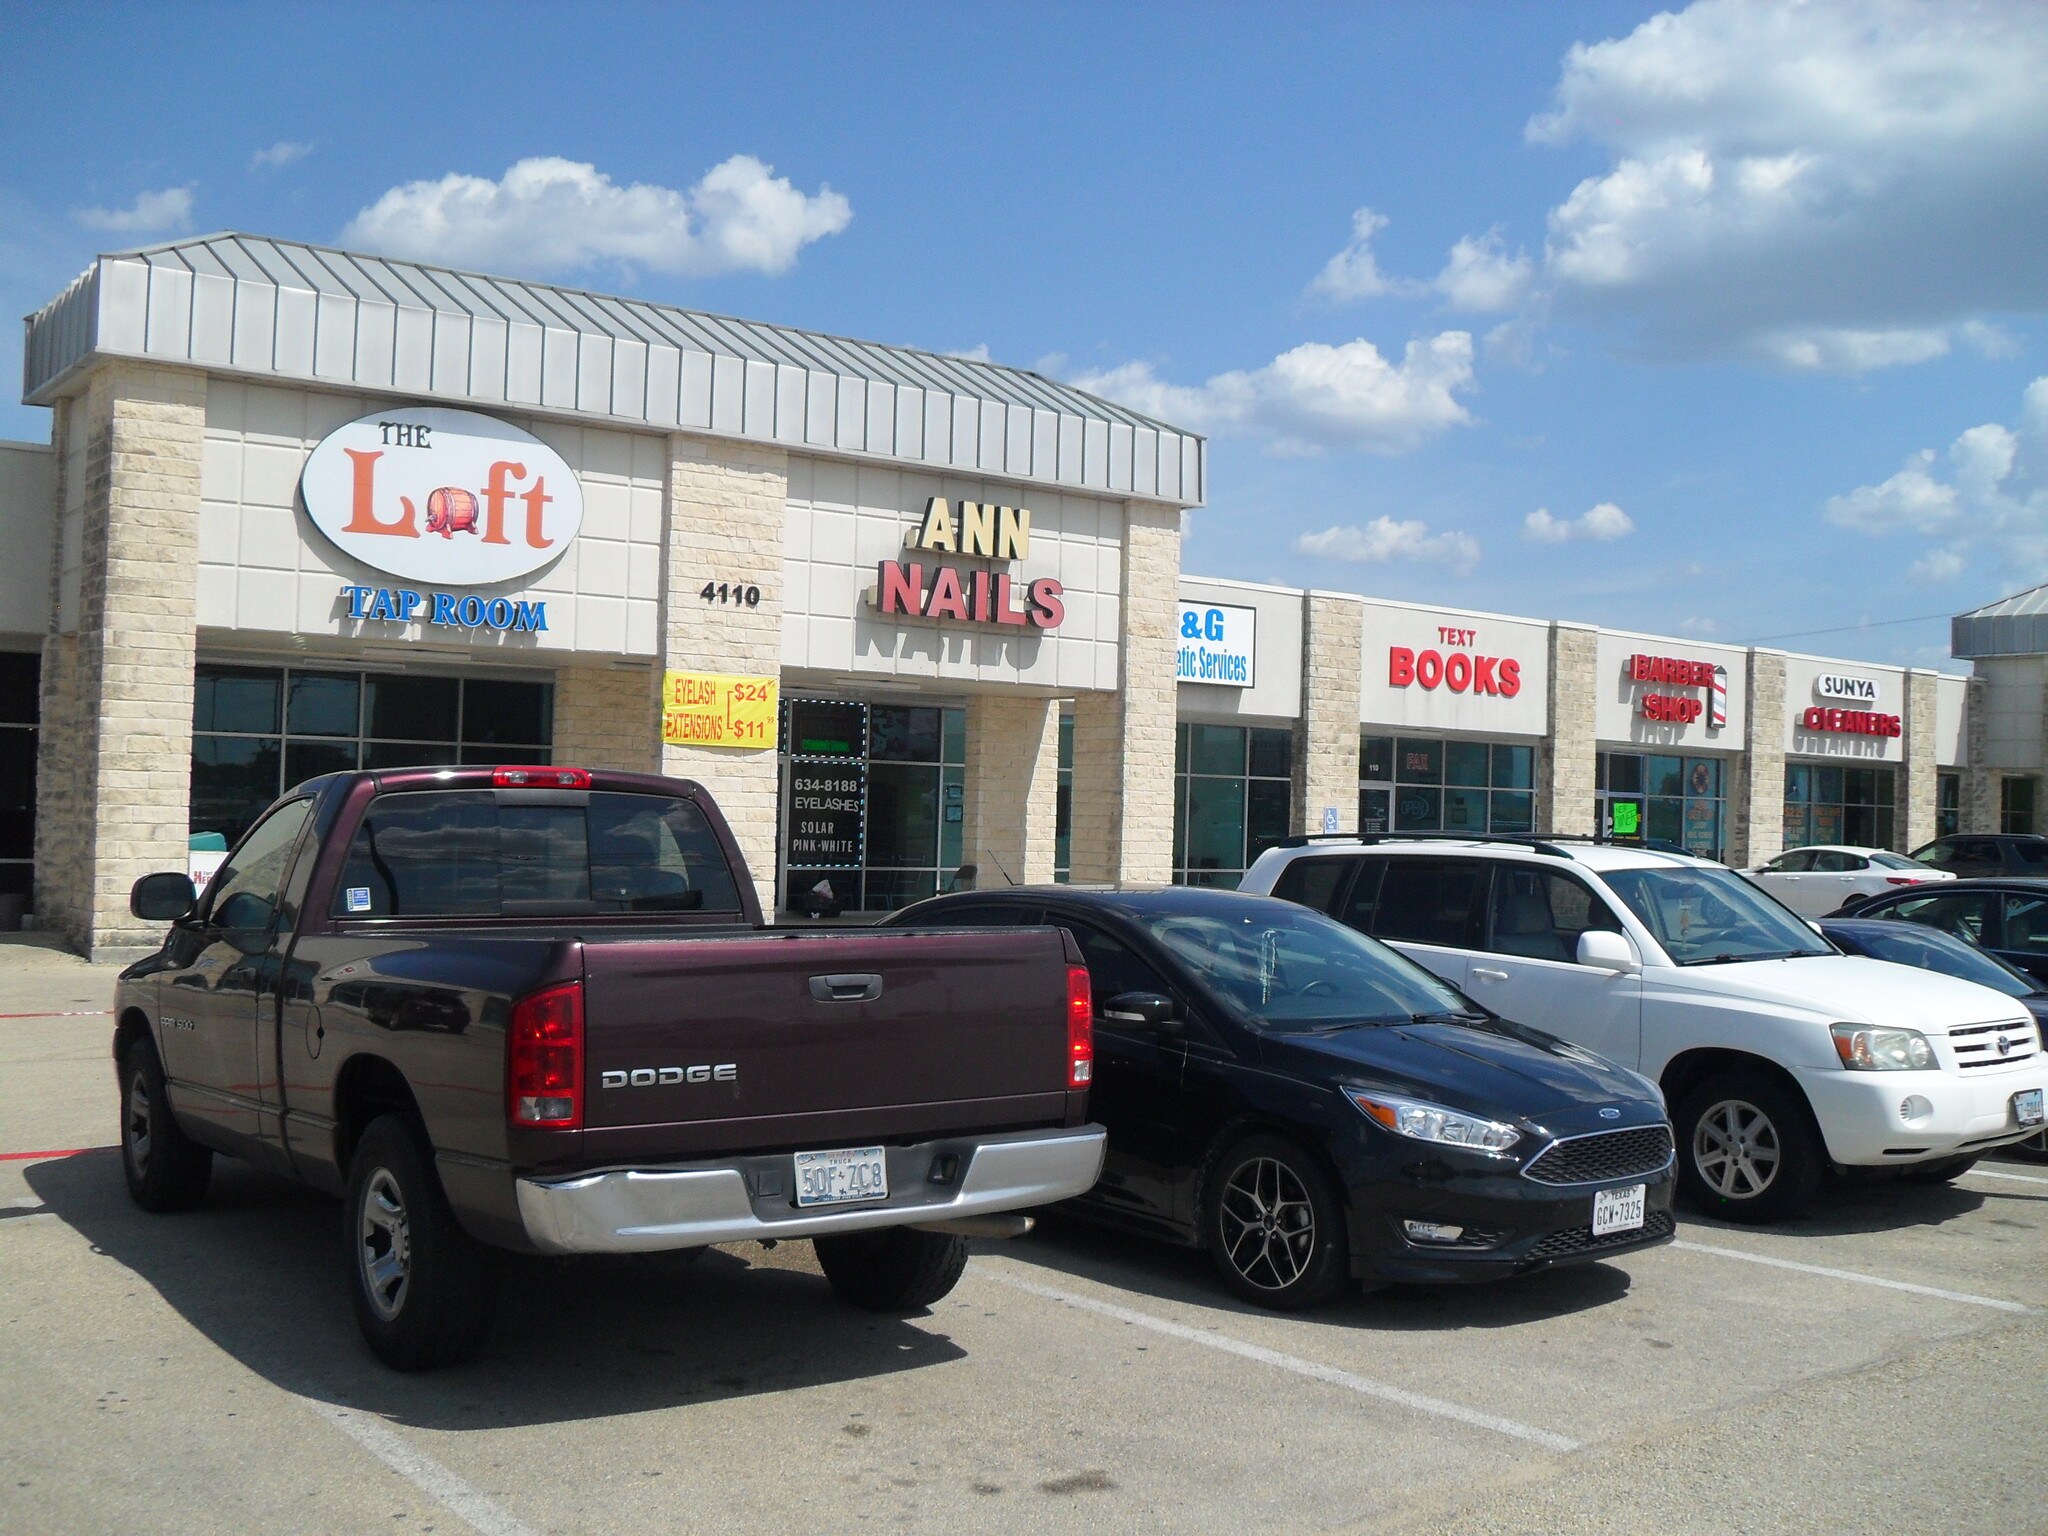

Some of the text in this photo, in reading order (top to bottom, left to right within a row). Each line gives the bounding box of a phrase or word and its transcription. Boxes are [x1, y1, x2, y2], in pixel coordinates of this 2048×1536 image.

[378, 421, 432, 449] THE
[918, 496, 1031, 560] ANN
[700, 581, 760, 607] 4110
[877, 560, 1065, 629] NAILS
[342, 585, 549, 632] TAP ROOM
[1438, 625, 1477, 647] TEXT
[1199, 646, 1247, 682] Services
[1389, 645, 1521, 698] BOOKS
[1630, 654, 1715, 688] BARBER
[674, 678, 716, 706] EYELASH
[734, 682, 768, 702] $24
[1824, 676, 1876, 699] SUNYA
[1642, 693, 1703, 724] SHOP
[1803, 706, 1901, 738] CLEANERS
[665, 712, 723, 740] EXTENSIONS
[733, 718, 764, 739] $11
[1406, 752, 1430, 771] FAX
[794, 778, 858, 792] 634-8188
[795, 796, 860, 813] EYELASHES
[800, 821, 834, 834] SOLAR
[601, 1063, 737, 1089] DODGE
[1611, 1188, 1631, 1201] TEXAS
